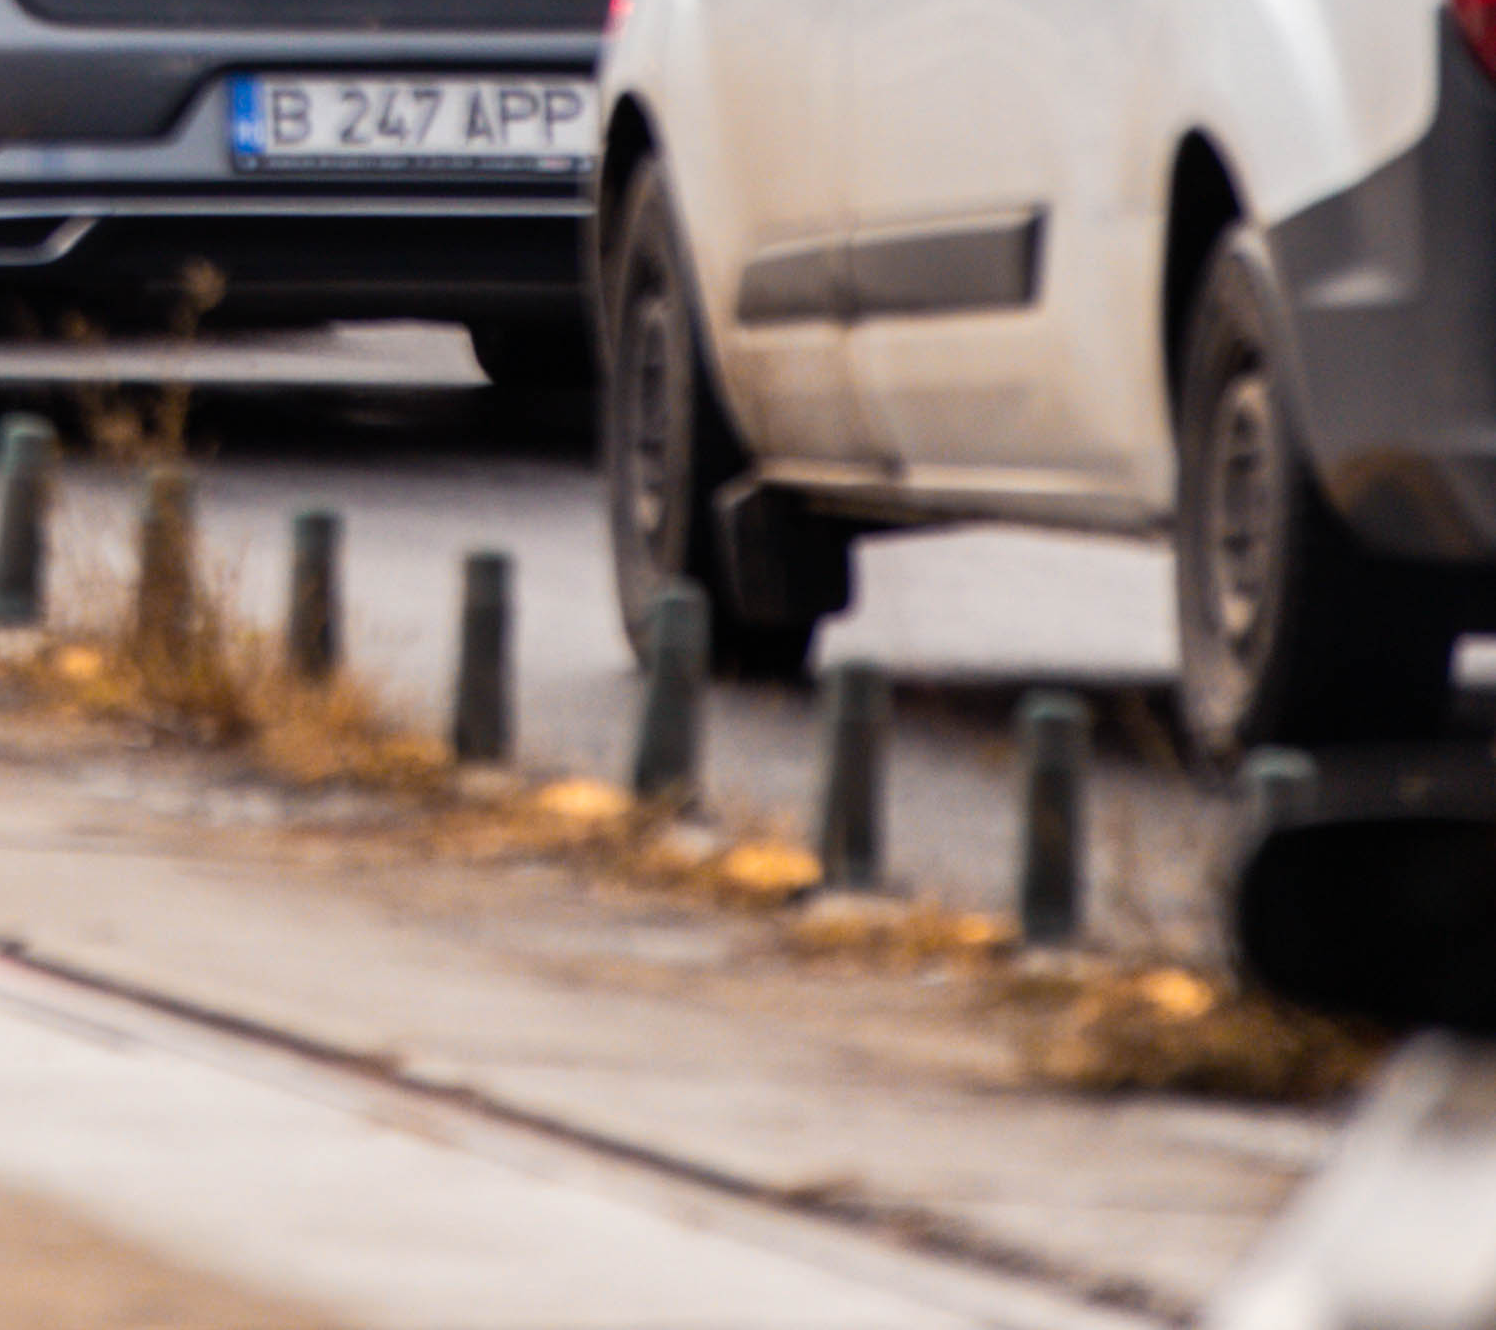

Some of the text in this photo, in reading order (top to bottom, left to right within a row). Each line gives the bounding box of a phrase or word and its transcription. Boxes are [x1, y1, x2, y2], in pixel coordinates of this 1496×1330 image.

[272, 89, 586, 146] B 247 APP
